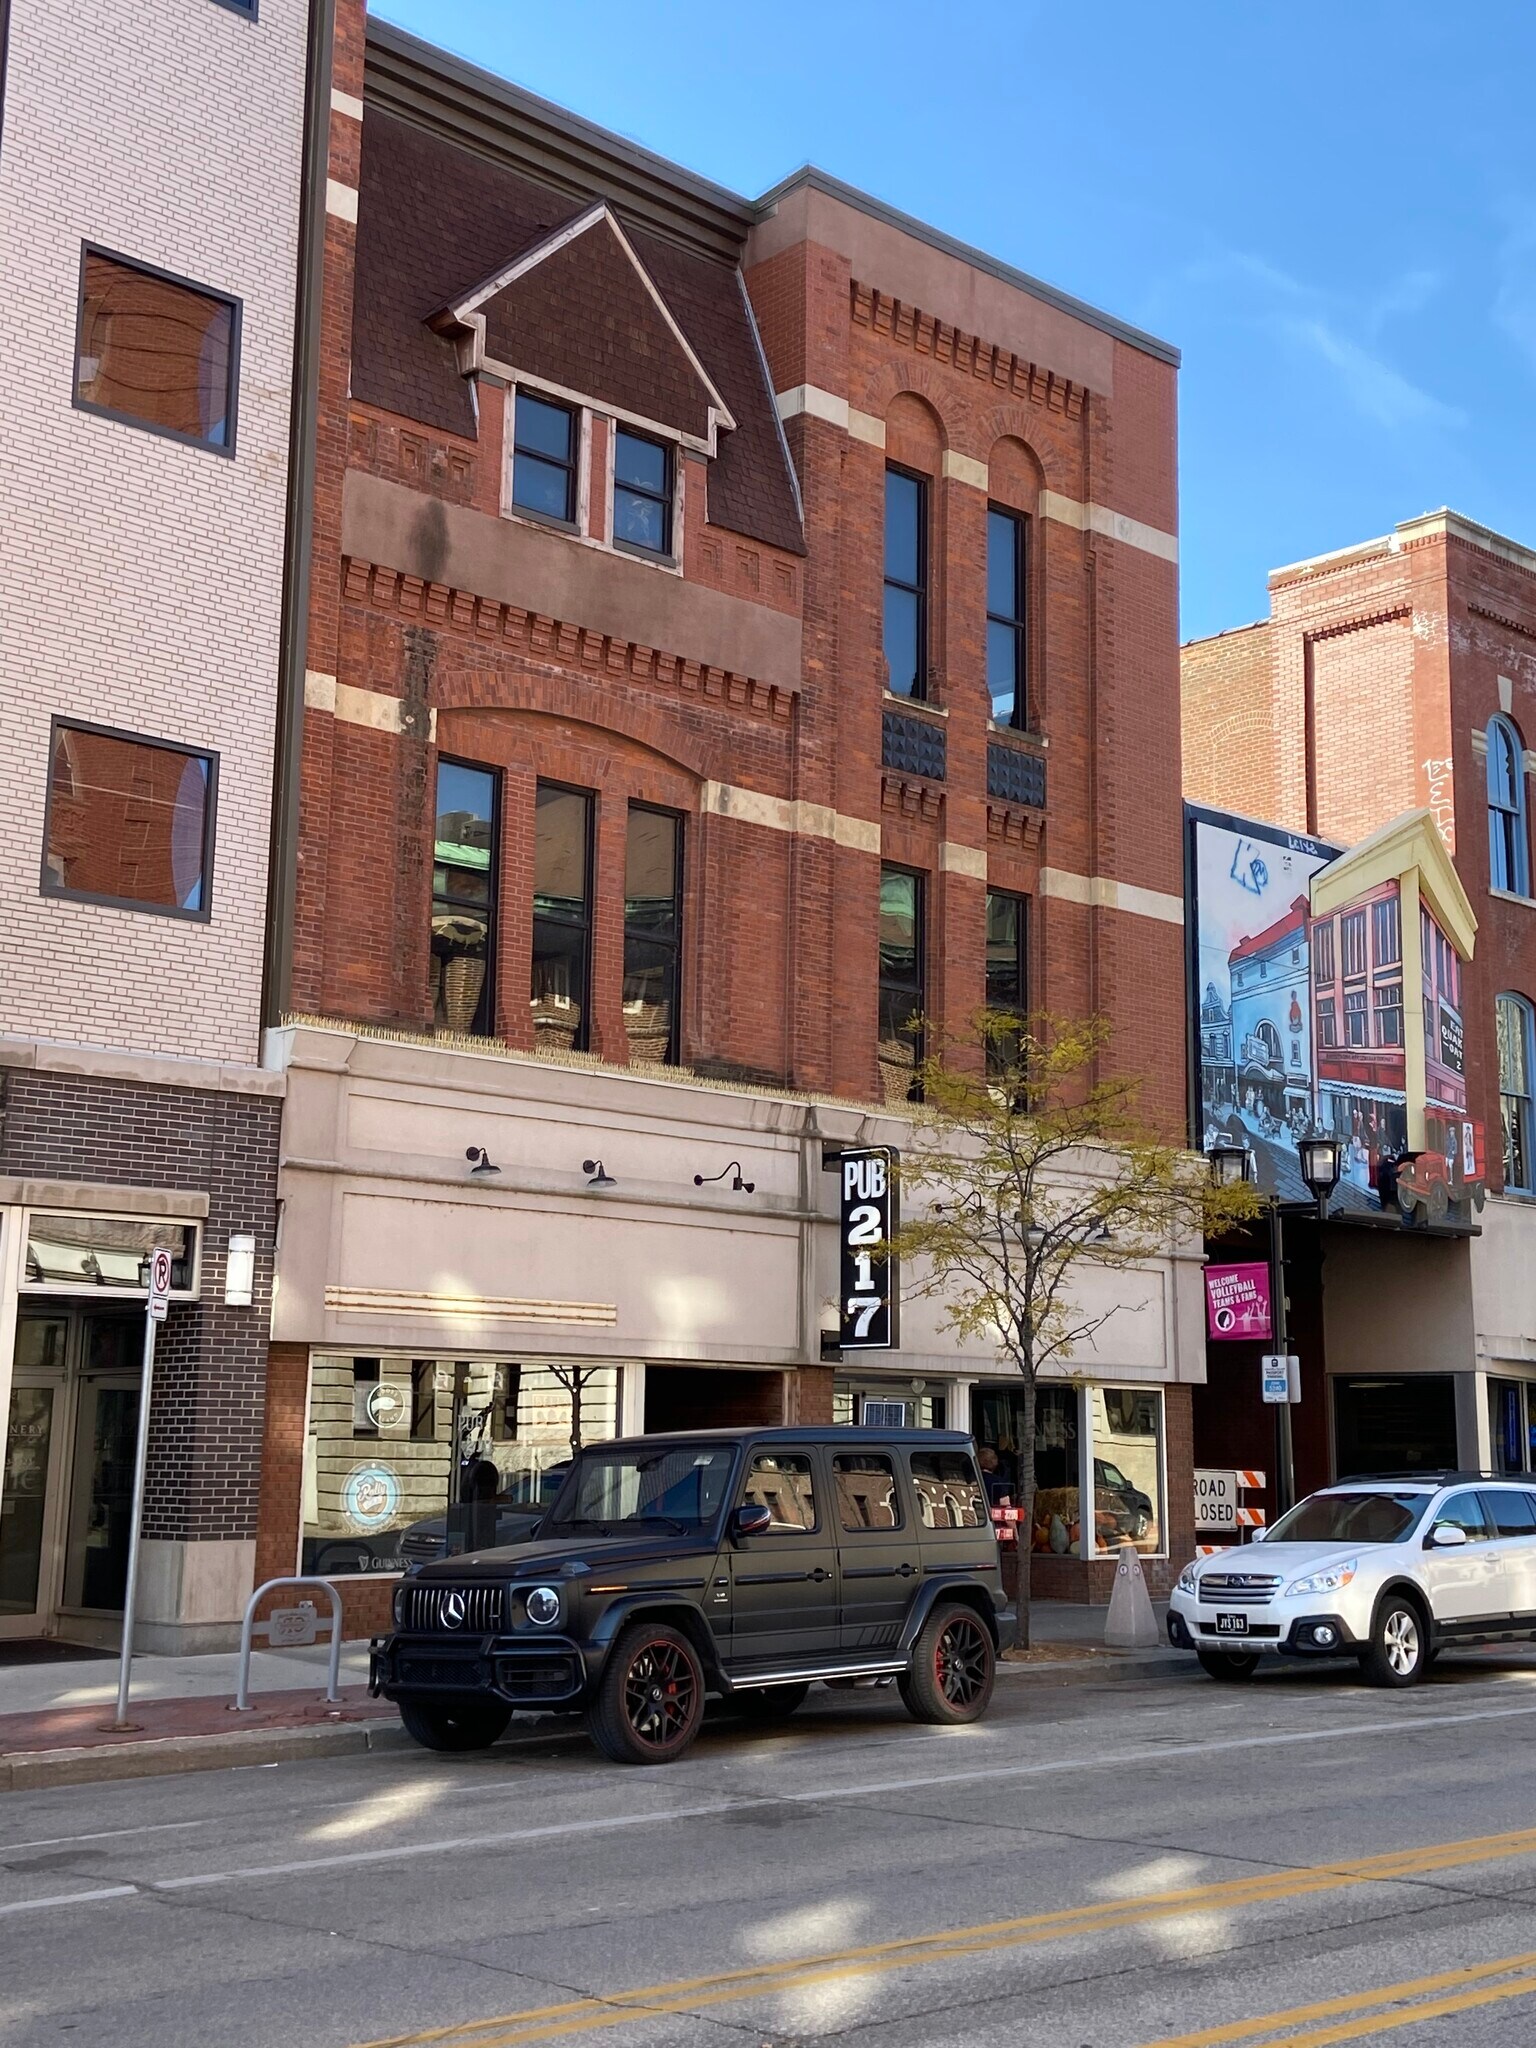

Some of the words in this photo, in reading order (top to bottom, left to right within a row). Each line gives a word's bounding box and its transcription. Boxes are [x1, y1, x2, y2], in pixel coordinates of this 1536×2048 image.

[844, 1159, 886, 1200] PUB
[1208, 1274, 1238, 1290] WELCOME
[1210, 1279, 1256, 1300] VOLLEYBALL
[1213, 1296, 1235, 1309] TEAMS
[1235, 1296, 1241, 1304] &
[1241, 1291, 1257, 1302] FANS
[1194, 1503, 1233, 1521] OSED
[371, 1556, 413, 1570] GUINNESS
